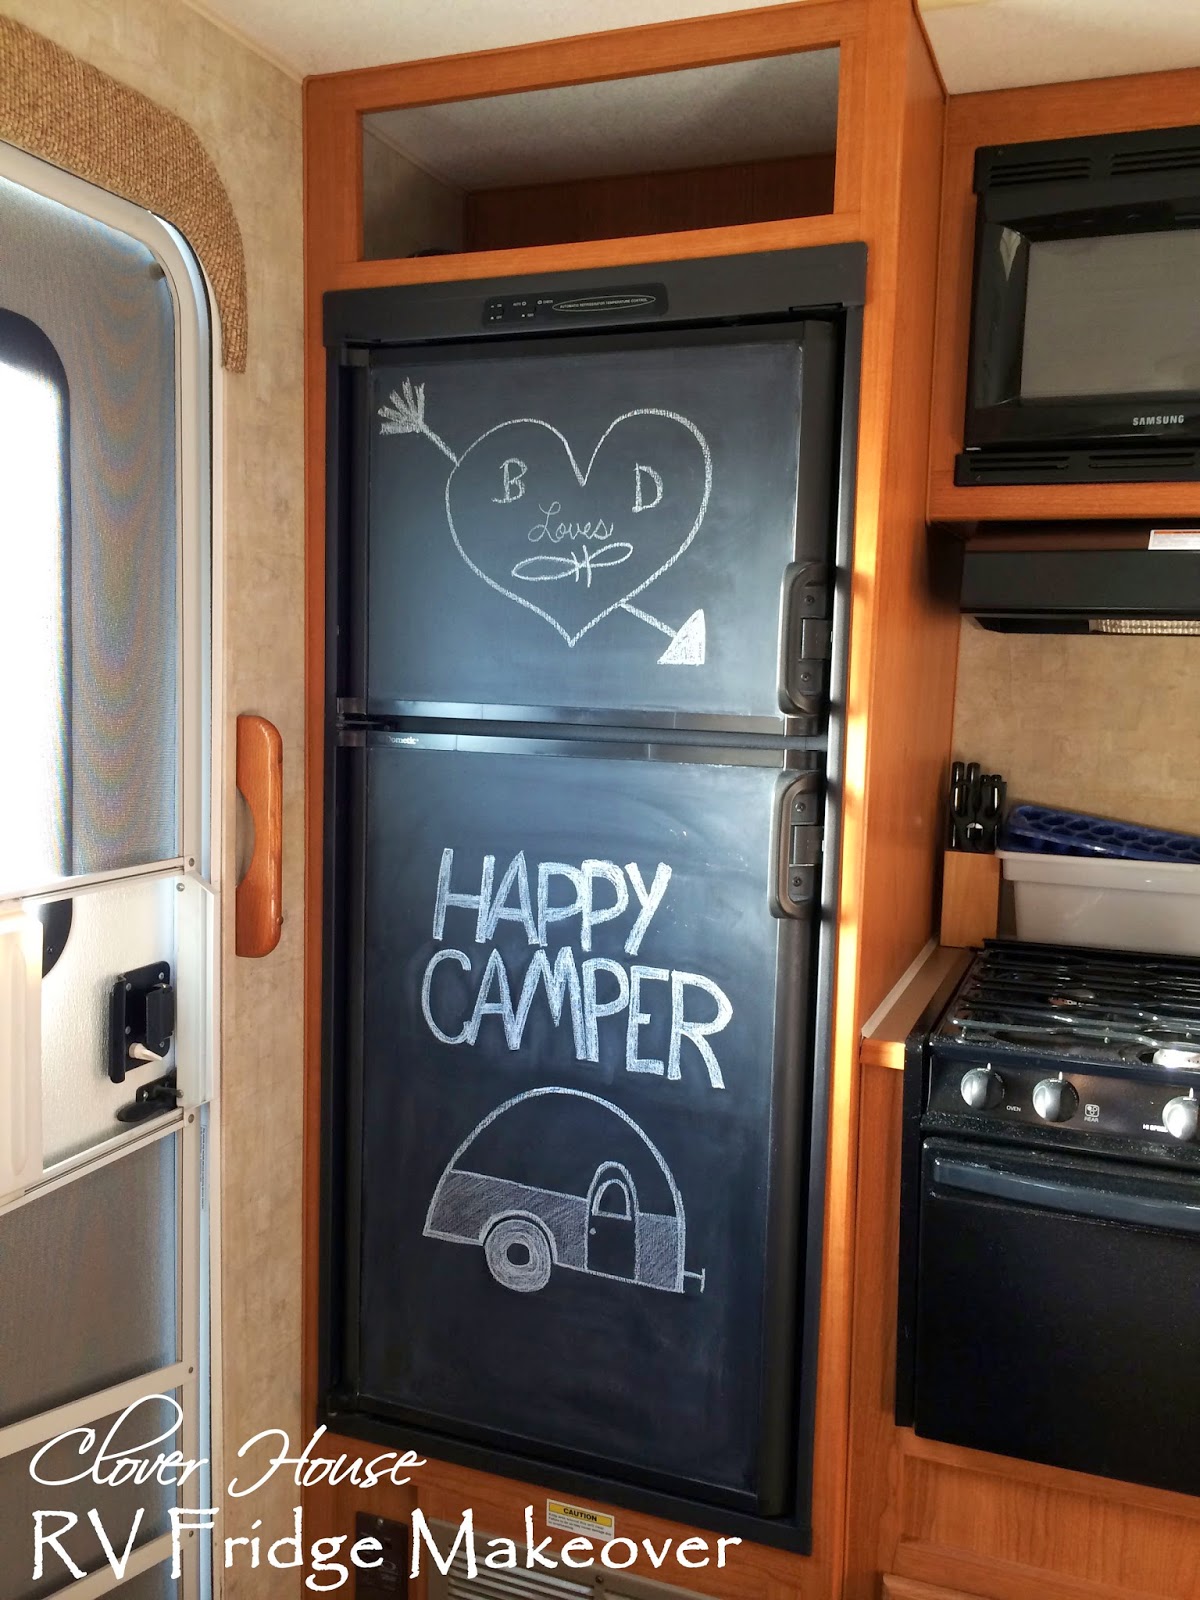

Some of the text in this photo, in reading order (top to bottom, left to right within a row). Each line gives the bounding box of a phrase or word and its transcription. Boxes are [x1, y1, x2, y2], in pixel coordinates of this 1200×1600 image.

[1132, 414, 1185, 426] SAMSUNG
[490, 457, 528, 504] B
[631, 462, 664, 513] D
[527, 501, 615, 543] Loves
[432, 847, 673, 956] HAPPY
[421, 946, 734, 1090] CAMPER
[563, 1508, 597, 1521] CAUTION
